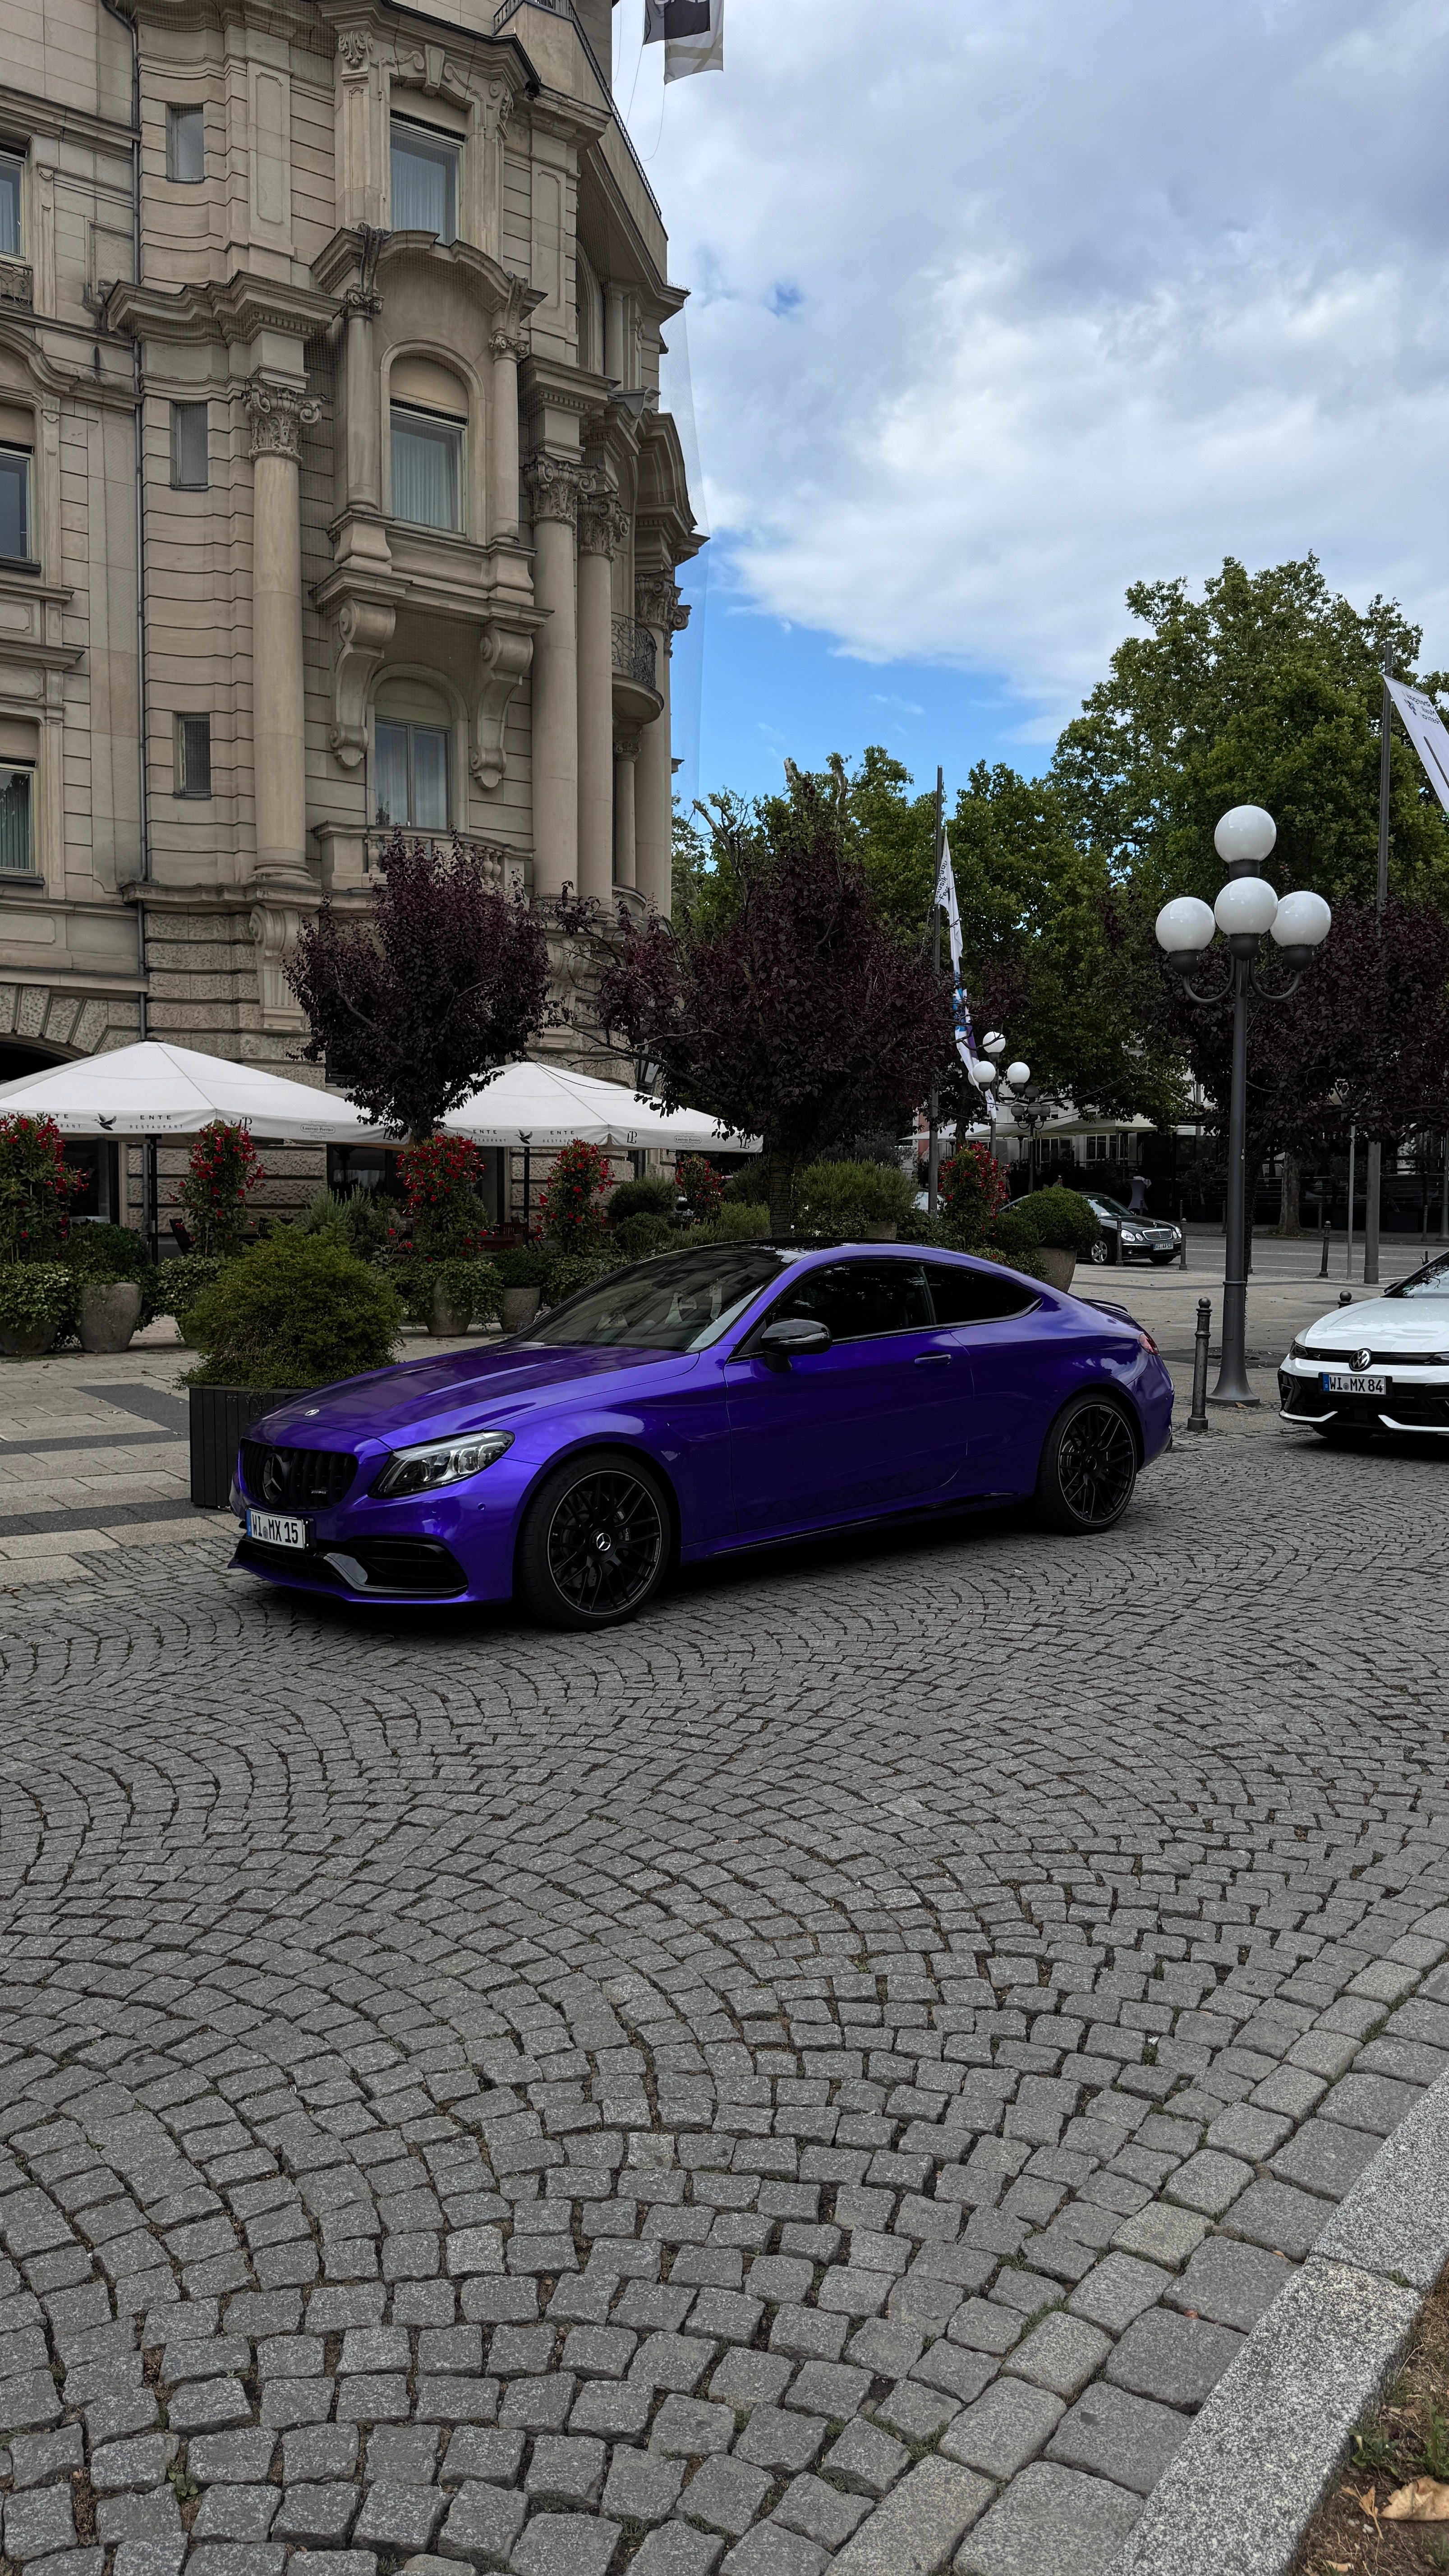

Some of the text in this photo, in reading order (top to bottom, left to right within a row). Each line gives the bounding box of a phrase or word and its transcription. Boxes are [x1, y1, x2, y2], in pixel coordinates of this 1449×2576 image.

[1329, 1377, 1383, 1393] WI MX 84
[252, 1514, 299, 1544] WI MX 15
